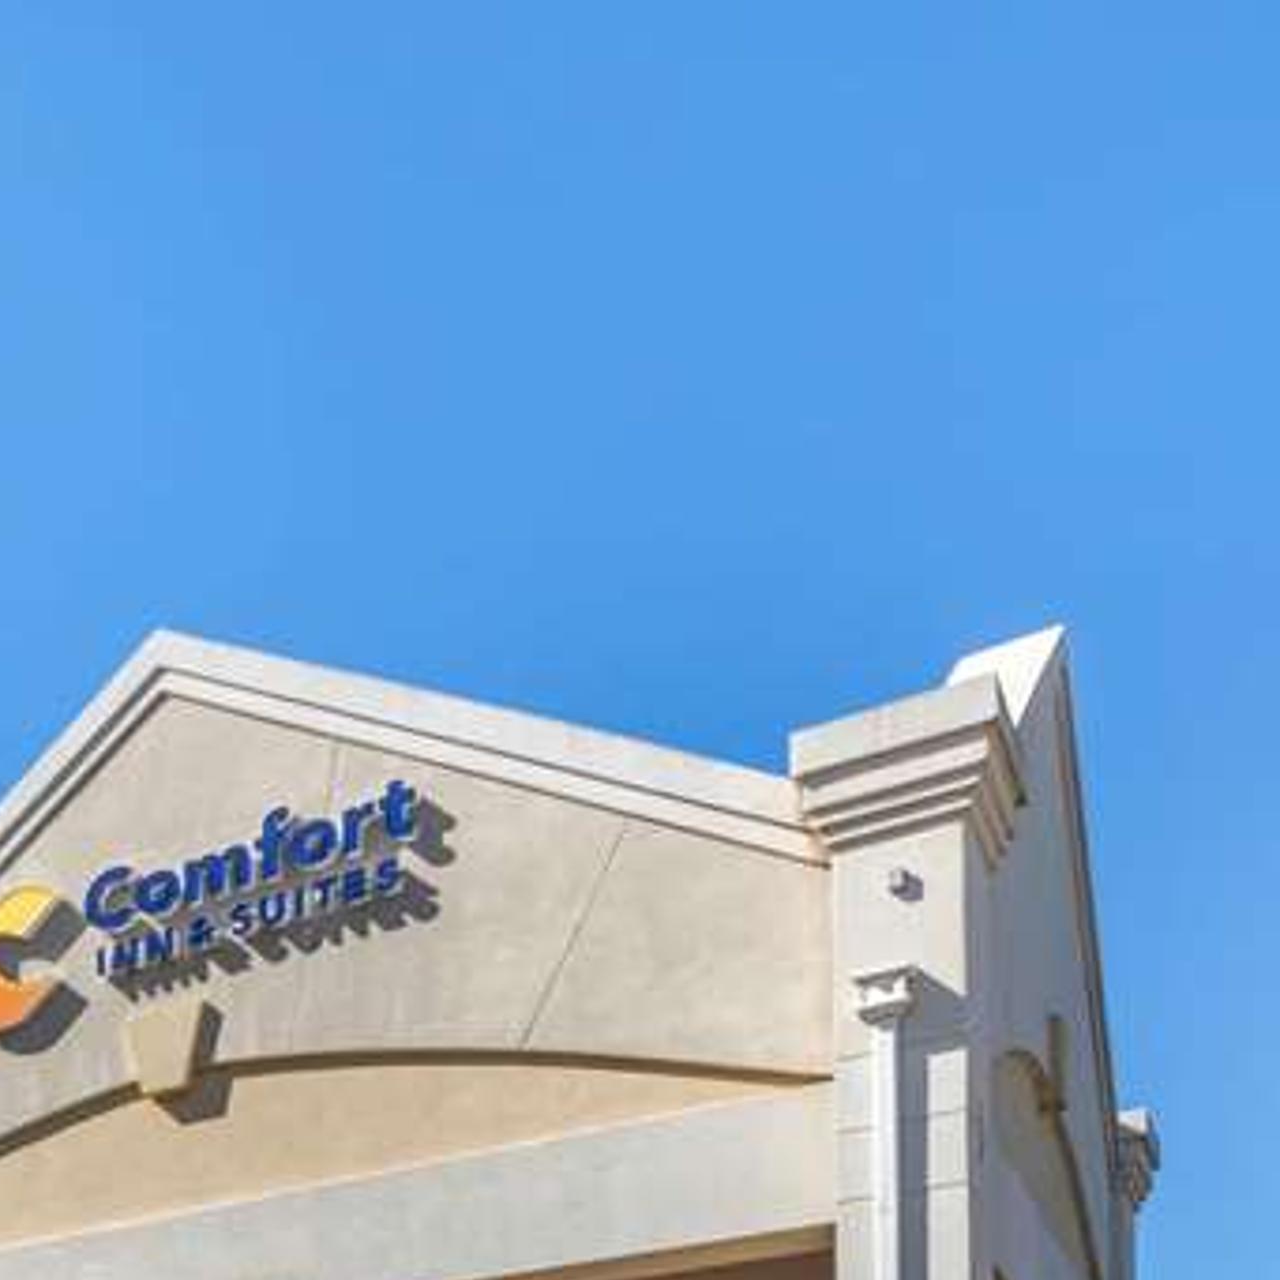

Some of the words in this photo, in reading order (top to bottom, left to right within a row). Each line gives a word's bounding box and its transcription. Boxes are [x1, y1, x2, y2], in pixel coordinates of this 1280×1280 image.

[83, 780, 415, 931] Comfort
[95, 920, 175, 976] INN
[187, 917, 215, 947] &
[231, 857, 400, 935] SUITES
